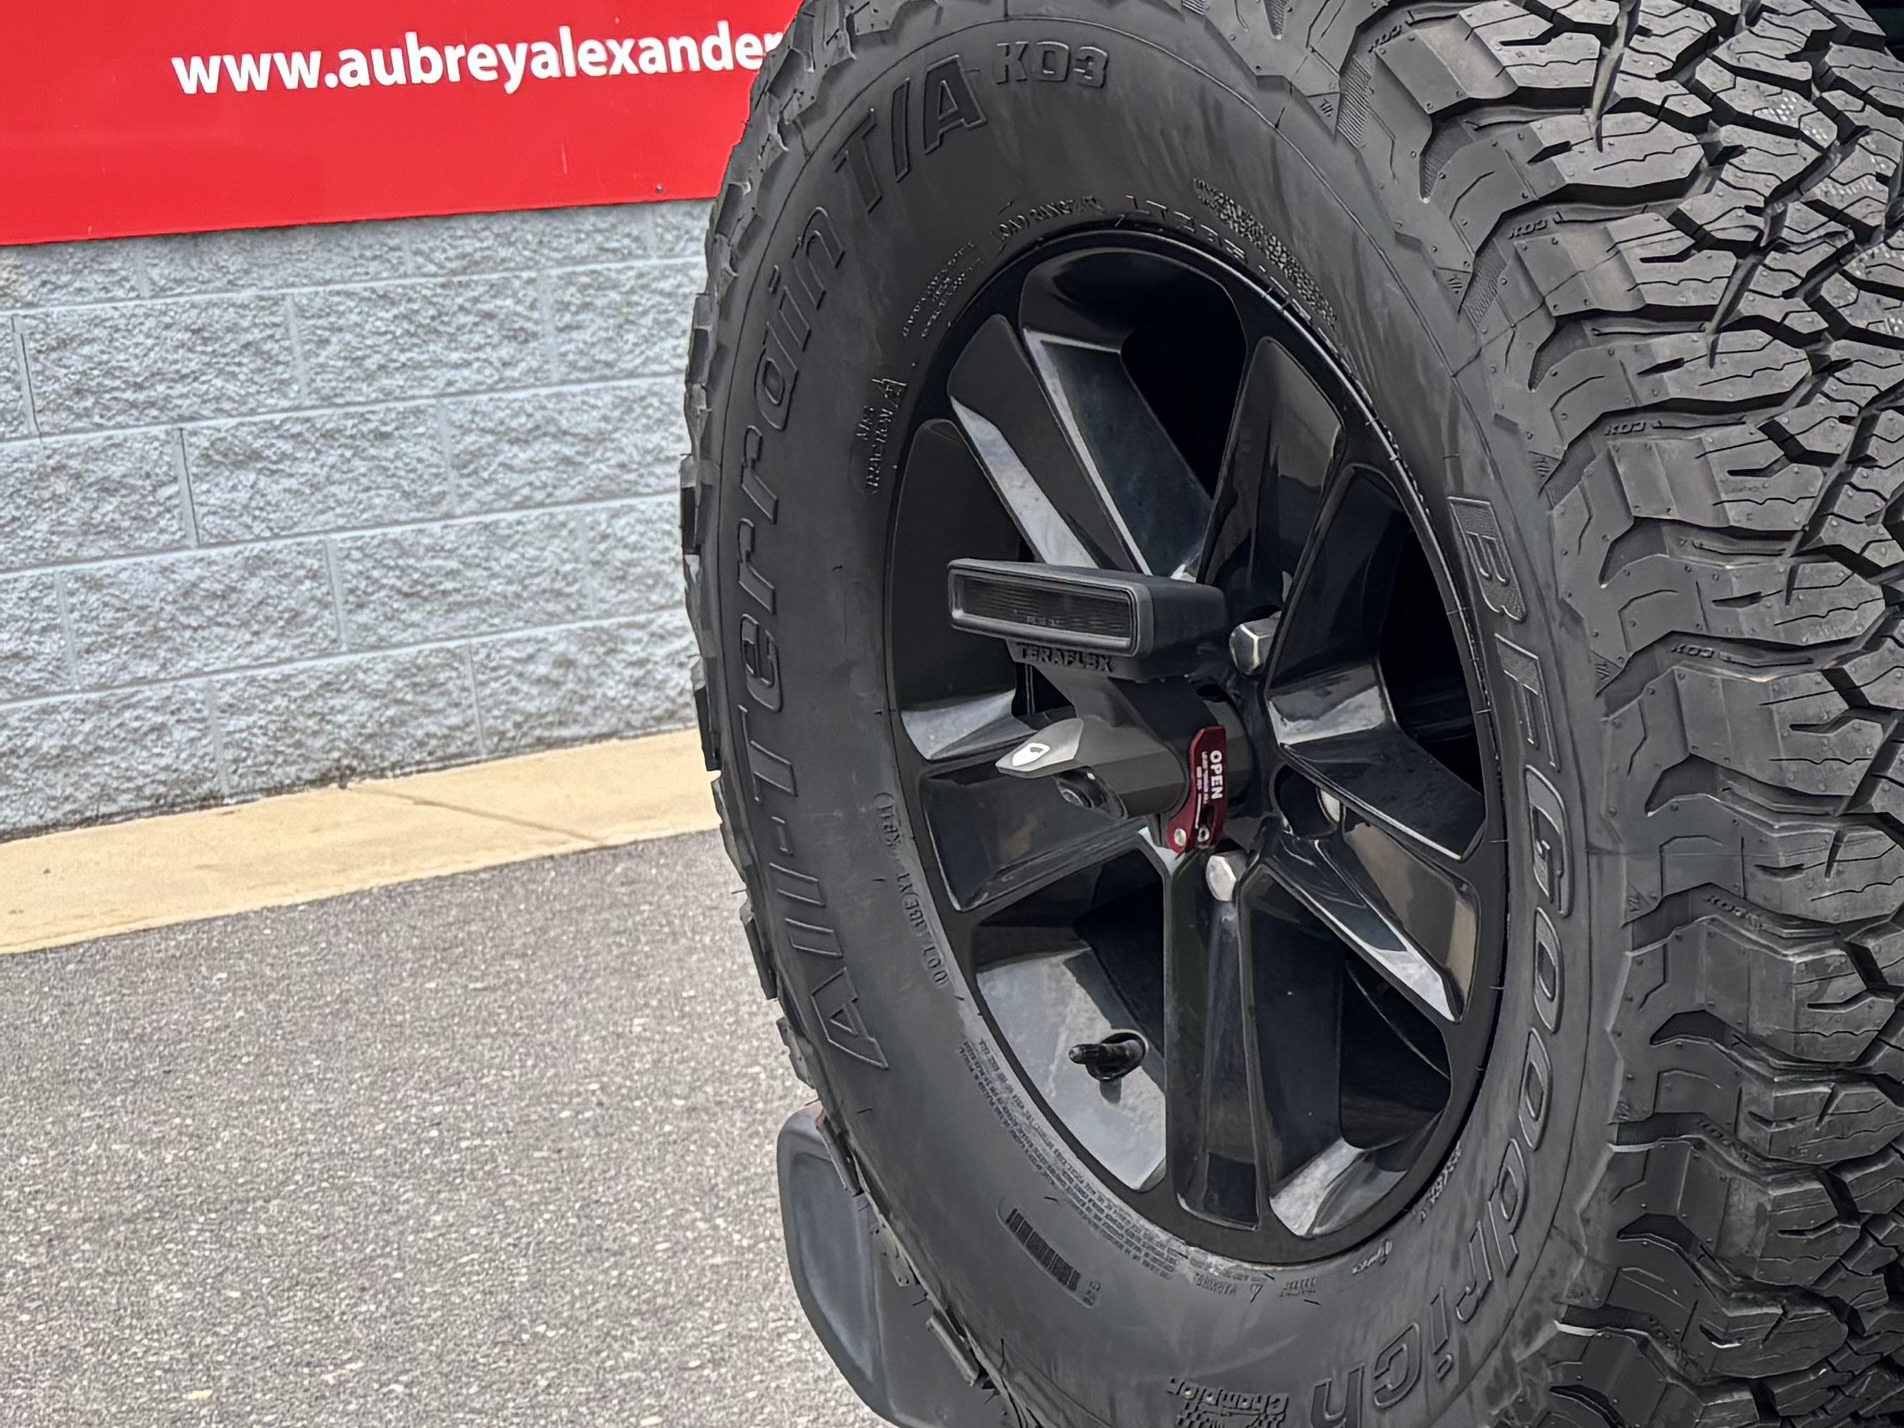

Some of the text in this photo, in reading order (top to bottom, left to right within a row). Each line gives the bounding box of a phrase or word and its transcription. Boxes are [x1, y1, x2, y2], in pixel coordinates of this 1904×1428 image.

[171, 20, 784, 96] www.aubreyalexander
[833, 54, 987, 213] T/A
[1017, 643, 1114, 673] TERAFLEX
[1210, 749, 1224, 800] OPEN
